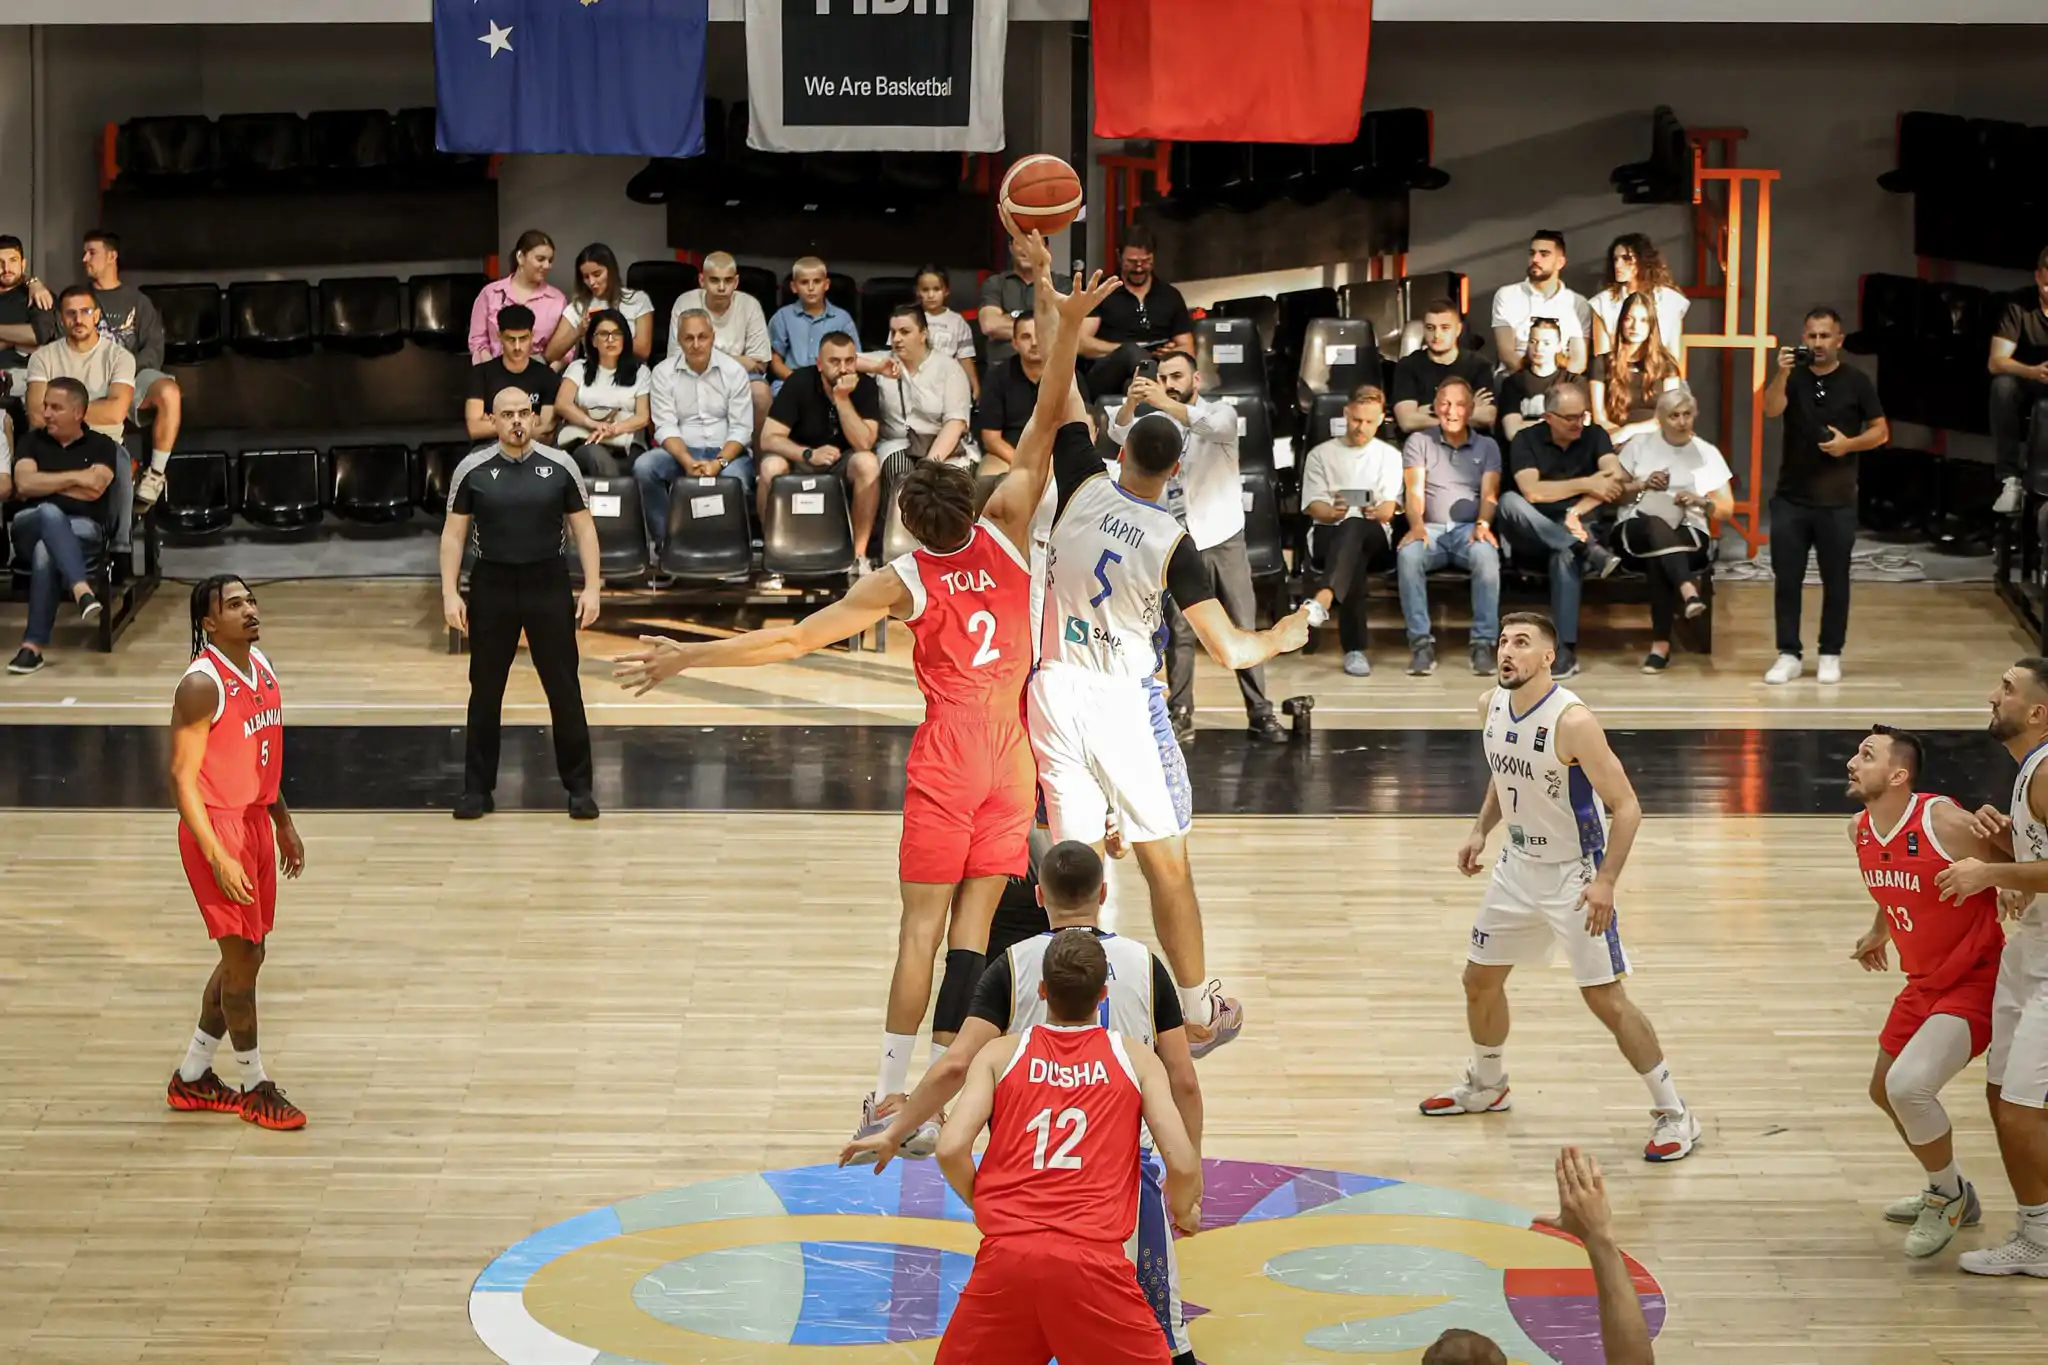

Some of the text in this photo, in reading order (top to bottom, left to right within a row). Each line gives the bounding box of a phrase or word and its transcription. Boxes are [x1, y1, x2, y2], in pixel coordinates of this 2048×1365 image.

[804, 76, 835, 96] We
[839, 76, 872, 96] Are
[1099, 513, 1145, 549] KAPITI
[940, 569, 997, 595] TOLA
[1089, 548, 1123, 608] 5
[967, 609, 1001, 667] 2
[243, 708, 282, 739] ALBANIA
[261, 740, 269, 767] 5
[1490, 752, 1535, 781] KOSOVA
[1507, 786, 1518, 813] 7
[1863, 869, 1921, 893] ALBANIA
[1886, 905, 1914, 932] 13
[1029, 1057, 1110, 1089] DUSHA
[1026, 1107, 1088, 1170] 12
